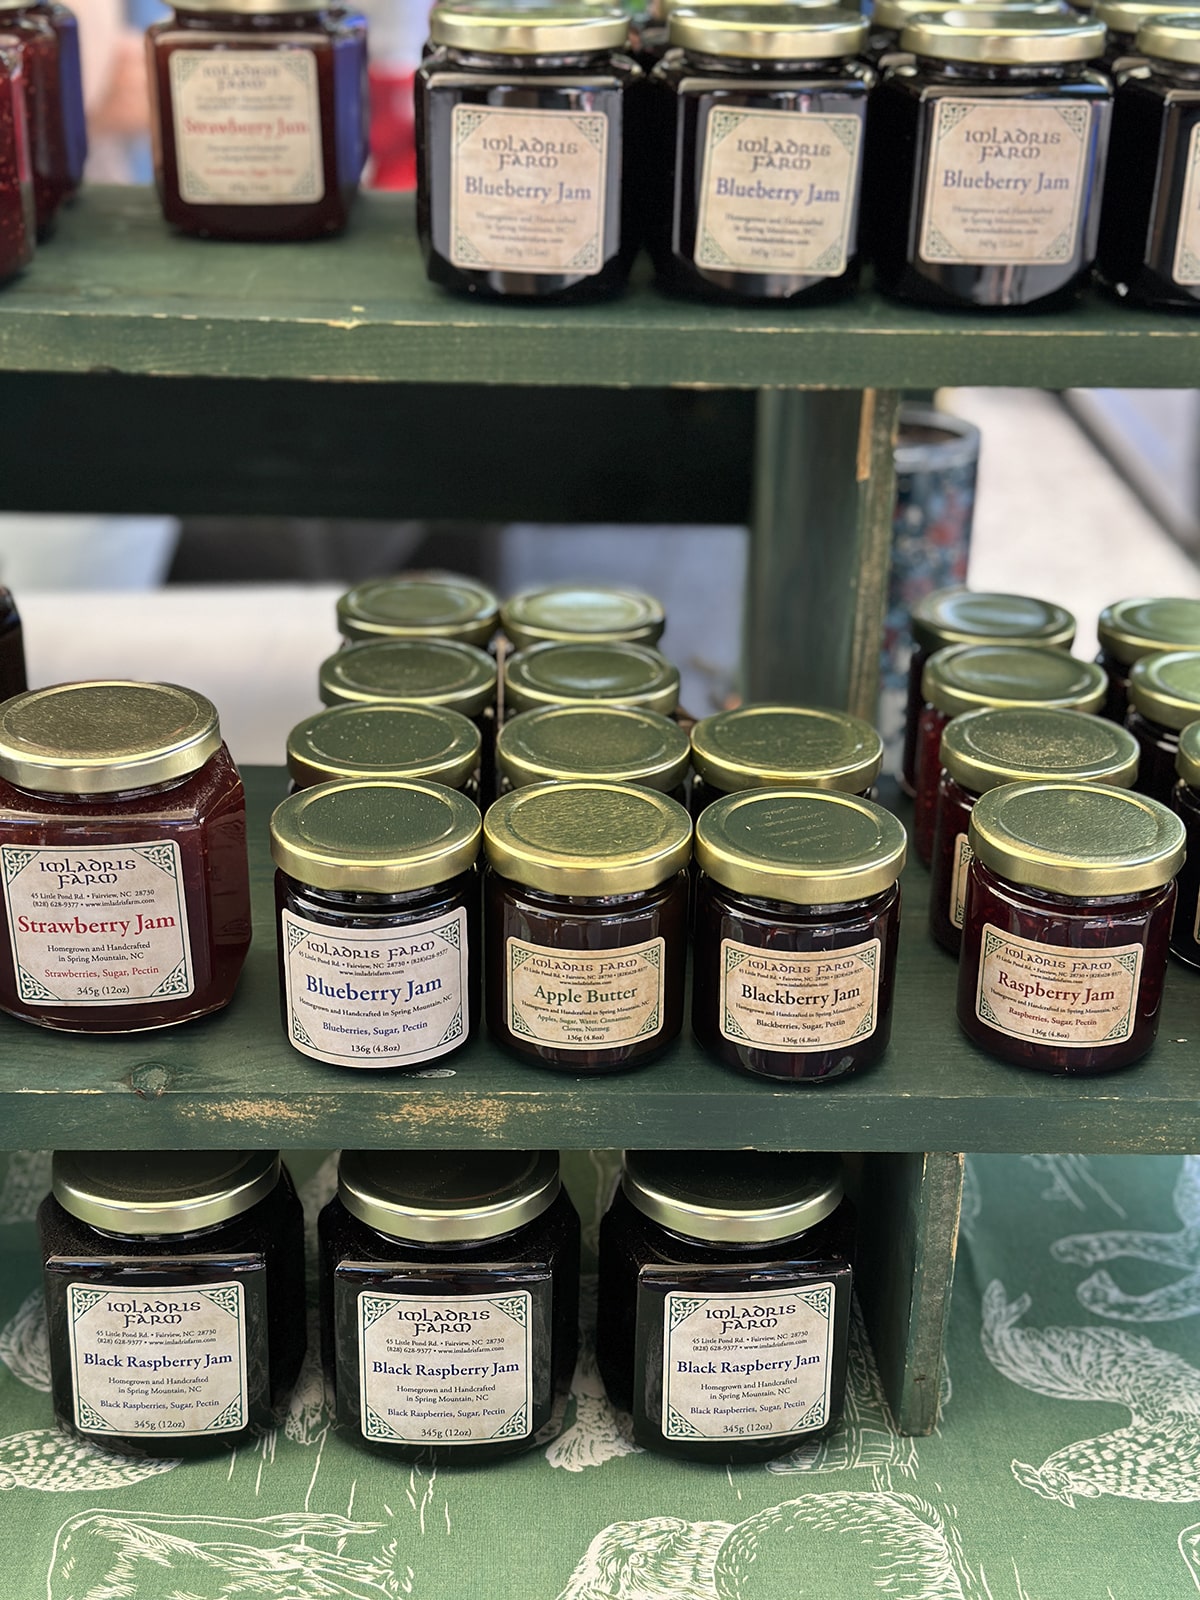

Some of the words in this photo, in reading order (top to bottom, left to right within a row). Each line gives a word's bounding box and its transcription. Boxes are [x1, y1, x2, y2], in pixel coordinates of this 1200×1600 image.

[943, 170, 1032, 195] Blueberry
[1034, 172, 1069, 194] Jam
[465, 176, 552, 203] Blueberry
[555, 182, 591, 203] Jam
[716, 177, 803, 206] Blueberry
[805, 183, 840, 205] Jam
[18, 916, 130, 936] Strawberry
[135, 914, 176, 935] Jam
[48, 945, 90, 953] Homegrown
[107, 942, 150, 951] Handcrafted
[67, 955, 90, 963] Spring
[91, 954, 128, 962] Mountain,
[130, 952, 144, 960] NC
[45, 969, 100, 978] Strawberries,
[102, 969, 129, 979] Sugar,
[132, 967, 159, 975] Pectin
[77, 987, 99, 996] 345g
[102, 985, 130, 995] (12oz)
[306, 975, 401, 1004] Blueberry
[405, 978, 442, 1002] Jam
[998, 971, 1081, 1006] Raspberry
[1082, 988, 1114, 1005] Jam
[534, 985, 582, 1006] Apple
[587, 988, 638, 1003] Butter
[741, 984, 830, 1008] Blackberry
[832, 988, 860, 1006] Jam
[299, 997, 329, 1012] Homegrown
[342, 1009, 381, 1017] Handcrafted
[391, 1008, 411, 1016] Spring
[412, 1000, 442, 1012] Mountain,
[442, 994, 452, 1002] NC
[1009, 1007, 1049, 1023] Raspberries,
[1052, 1016, 1072, 1026] Sugar,
[1075, 1018, 1097, 1026] Pectin
[323, 1022, 371, 1036] Blueberries,
[373, 1027, 400, 1036] Sugar,
[402, 1022, 428, 1032] Pectin
[756, 1019, 800, 1030] Blackberries,
[802, 1023, 823, 1031] Sugar,
[825, 1020, 845, 1028] Pectin
[1032, 1028, 1046, 1037] 136g
[1048, 1031, 1070, 1039] (4.8oz)
[351, 1045, 371, 1054] 136g
[373, 1044, 401, 1053] (4.8oz)
[84, 1353, 122, 1367] Black
[127, 1356, 201, 1371] Raspberry
[204, 1353, 232, 1368] Jam
[677, 1361, 717, 1374] Black
[721, 1360, 792, 1375] Raspberry
[794, 1355, 820, 1369] Jam
[373, 1361, 411, 1375] Black
[416, 1364, 489, 1379] Raspberry
[491, 1363, 519, 1376] Jam
[108, 1377, 150, 1386] Homegrown
[166, 1376, 208, 1384] Handcrafted
[701, 1384, 742, 1392] Homegrown
[758, 1378, 797, 1388] Handcrafted
[127, 1387, 149, 1395] Spring
[397, 1386, 438, 1394] Homegrown
[454, 1385, 495, 1393] Handcrafted
[742, 1390, 776, 1398] Mountain,
[100, 1400, 120, 1408] Black
[123, 1402, 168, 1410] Raspberries,
[170, 1402, 193, 1410] Sugar,
[713, 1407, 757, 1416] Raspberries,
[759, 1404, 782, 1412] Sugar,
[784, 1400, 805, 1408] Pectin
[388, 1409, 408, 1417] Black
[411, 1410, 455, 1419] Raspberries,
[457, 1410, 480, 1418] Sugar,
[134, 1421, 156, 1429] 345g
[158, 1420, 185, 1429] (12oz)
[723, 1425, 744, 1434] 345g
[746, 1422, 772, 1432] (12oz)
[421, 1429, 442, 1438] 345g
[445, 1429, 472, 1437] (12oz)
